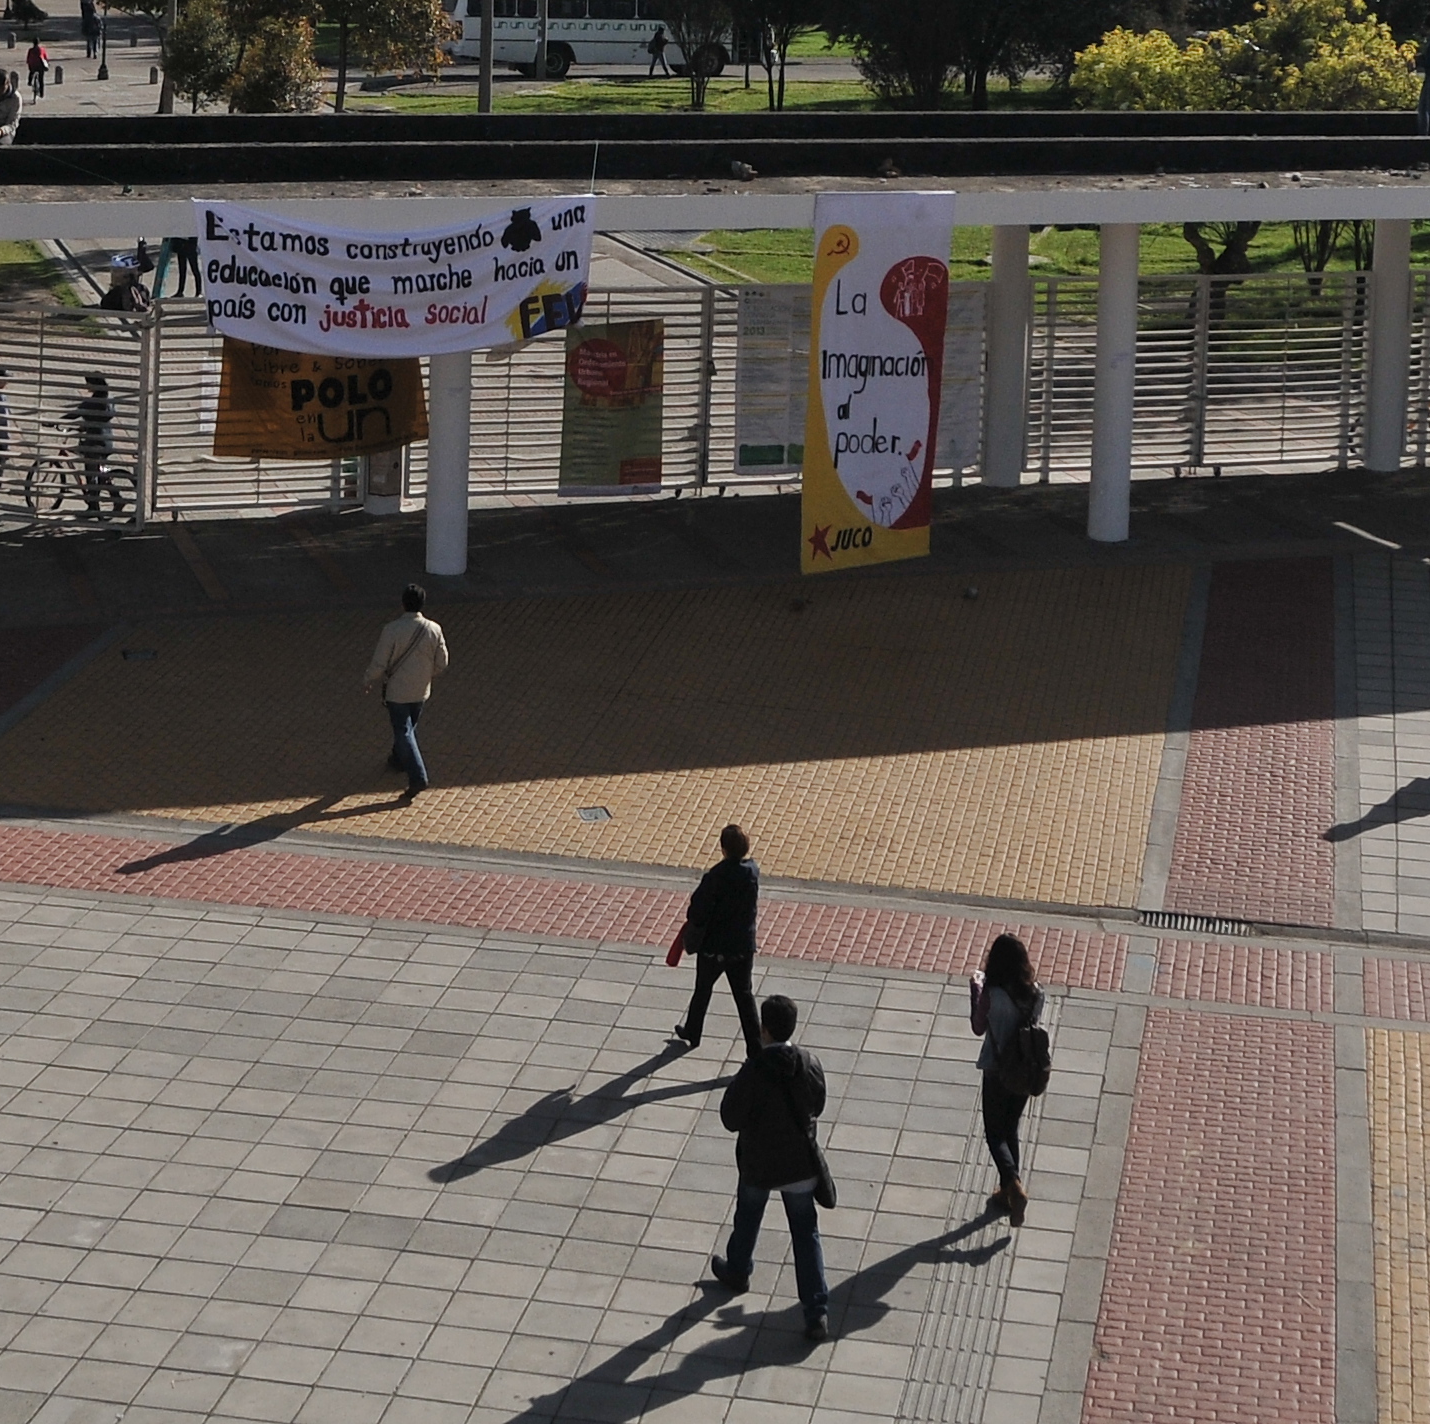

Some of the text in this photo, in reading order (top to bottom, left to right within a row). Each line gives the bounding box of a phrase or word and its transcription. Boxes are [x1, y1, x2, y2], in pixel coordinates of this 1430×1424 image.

[205, 205, 586, 263] Estamos construyendo una
[207, 250, 579, 306] educación que marche hacia un
[207, 293, 256, 329] país
[267, 301, 307, 324] con
[319, 298, 410, 333] justicia
[425, 295, 489, 325] social
[835, 279, 867, 316] La
[252, 361, 301, 374] Libre
[313, 361, 322, 372] &
[290, 368, 394, 412] POLO
[837, 394, 852, 421] al
[296, 412, 317, 424] en
[301, 430, 315, 443] la
[834, 417, 903, 469] poder.
[831, 527, 873, 552] JUCO
